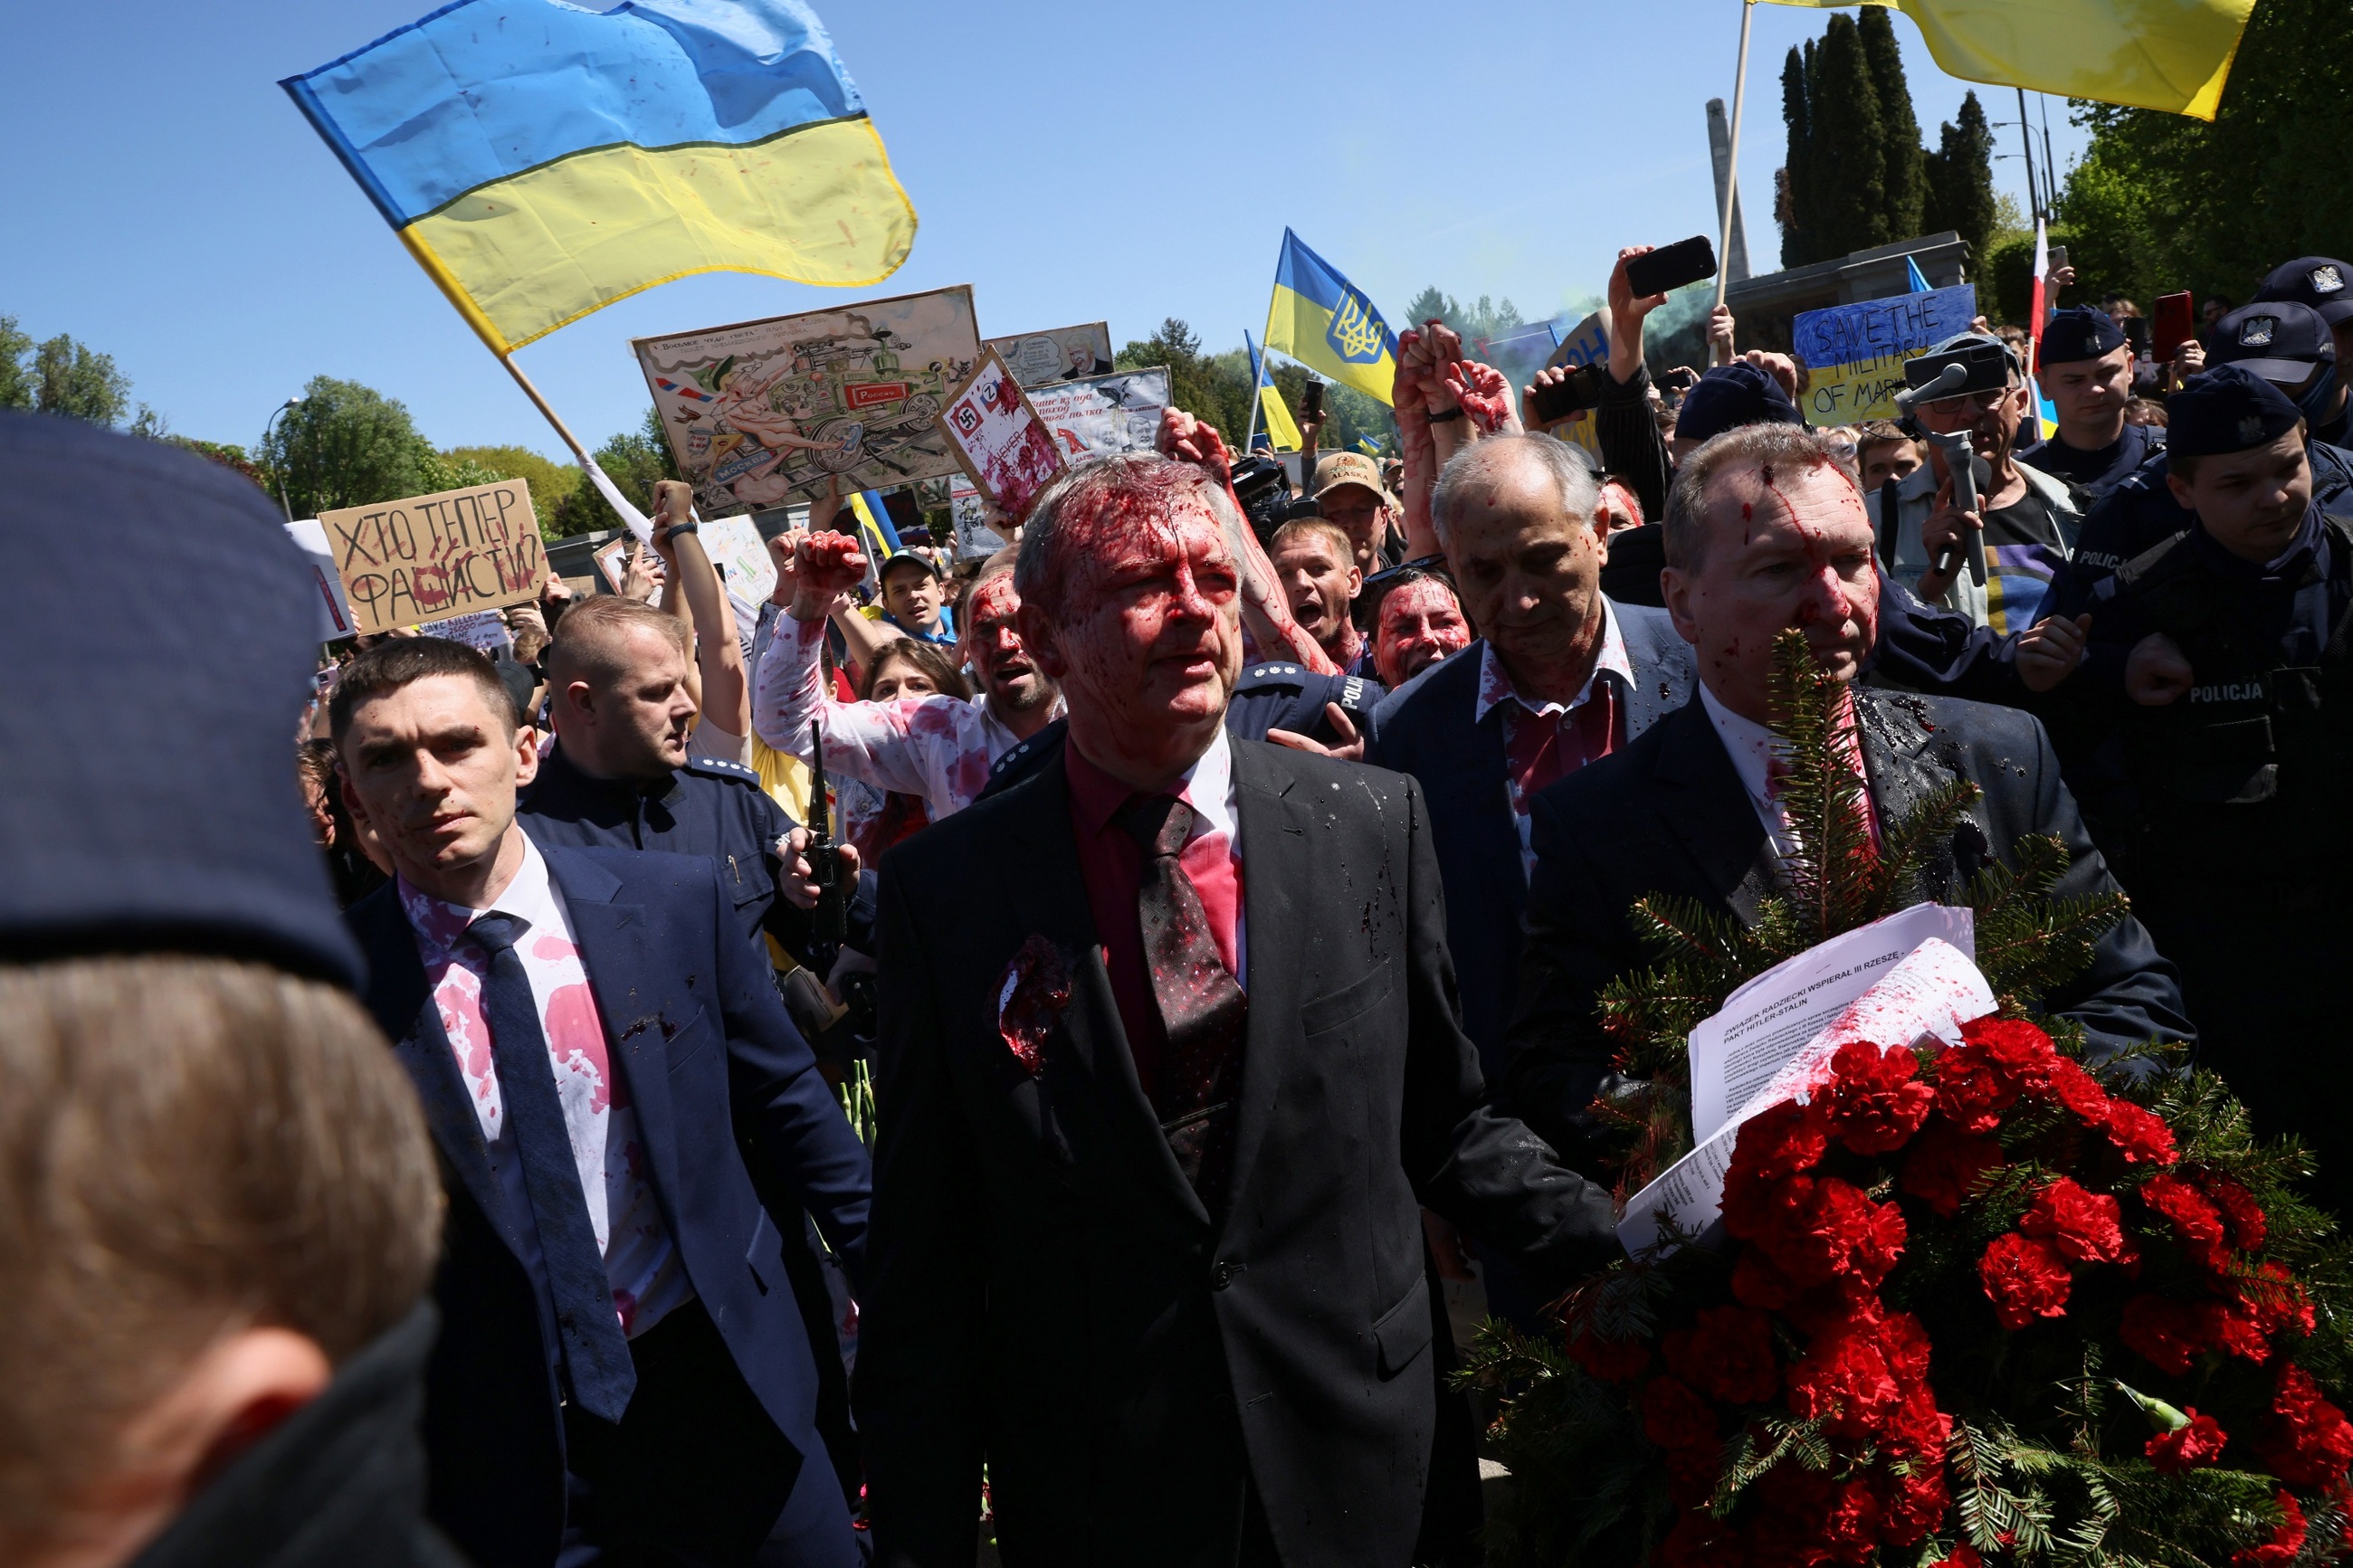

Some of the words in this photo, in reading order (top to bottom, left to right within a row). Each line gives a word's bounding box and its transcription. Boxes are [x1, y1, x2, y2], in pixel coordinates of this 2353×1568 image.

[1815, 309, 1882, 352] SAVE
[1884, 296, 1939, 338] THE
[1834, 336, 1929, 378] MILITARY
[860, 390, 895, 400] Россия
[1074, 394, 1092, 404] ада
[1814, 384, 1845, 413] OF
[1039, 406, 1070, 415] поход
[1069, 408, 1102, 420] полка
[992, 431, 1023, 466] NEVER
[719, 454, 767, 479] МОСКВА
[1330, 471, 1368, 480] ALASKA
[333, 509, 417, 571] ХТО
[414, 489, 516, 552] ТЕПЕР
[350, 533, 540, 627] ФАШИСТИ?
[448, 612, 481, 626] KILLED
[448, 622, 475, 635] 25000
[2190, 682, 2263, 703] POLICJA
[1723, 1012, 1760, 1036] ZWIĄZEK
[1761, 988, 1806, 1015] RADZIECKI
[1807, 970, 1853, 993] WSPIERAŁ
[1853, 965, 1862, 974] III
[1863, 951, 1900, 972] RZESZĘ
[1723, 1028, 1745, 1045] PAKT
[1747, 998, 1808, 1032] HITLER-STALIN
